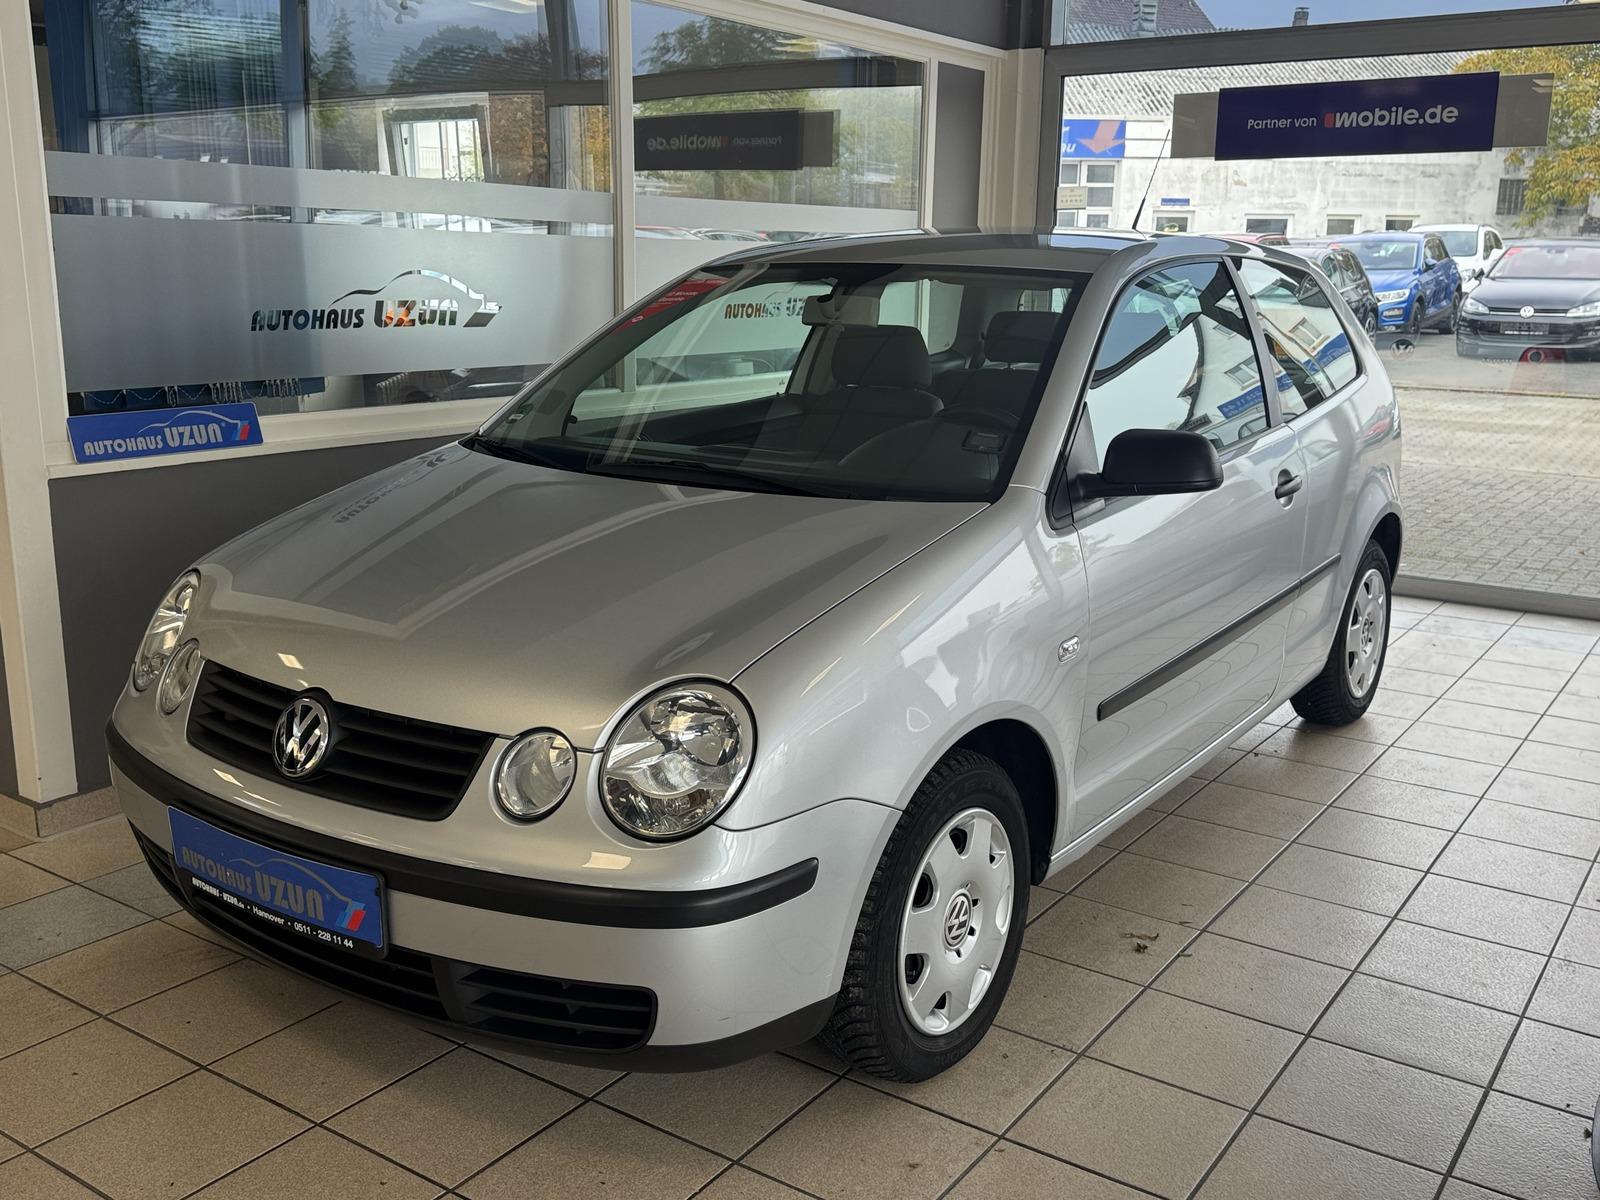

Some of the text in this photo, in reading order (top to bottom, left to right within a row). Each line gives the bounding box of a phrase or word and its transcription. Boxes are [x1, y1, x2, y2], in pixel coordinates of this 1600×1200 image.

[1247, 105, 1459, 129] Partner von mobile.de
[250, 299, 459, 331] AUTOHAUS UZUN
[83, 423, 223, 457] AUTOHAUS UZUN
[182, 846, 325, 922] AUTOHAUS UZUN
[252, 905, 285, 925] Hannover
[293, 921, 311, 935] 0511
[333, 935, 342, 945] 11
[343, 938, 354, 949] 44
